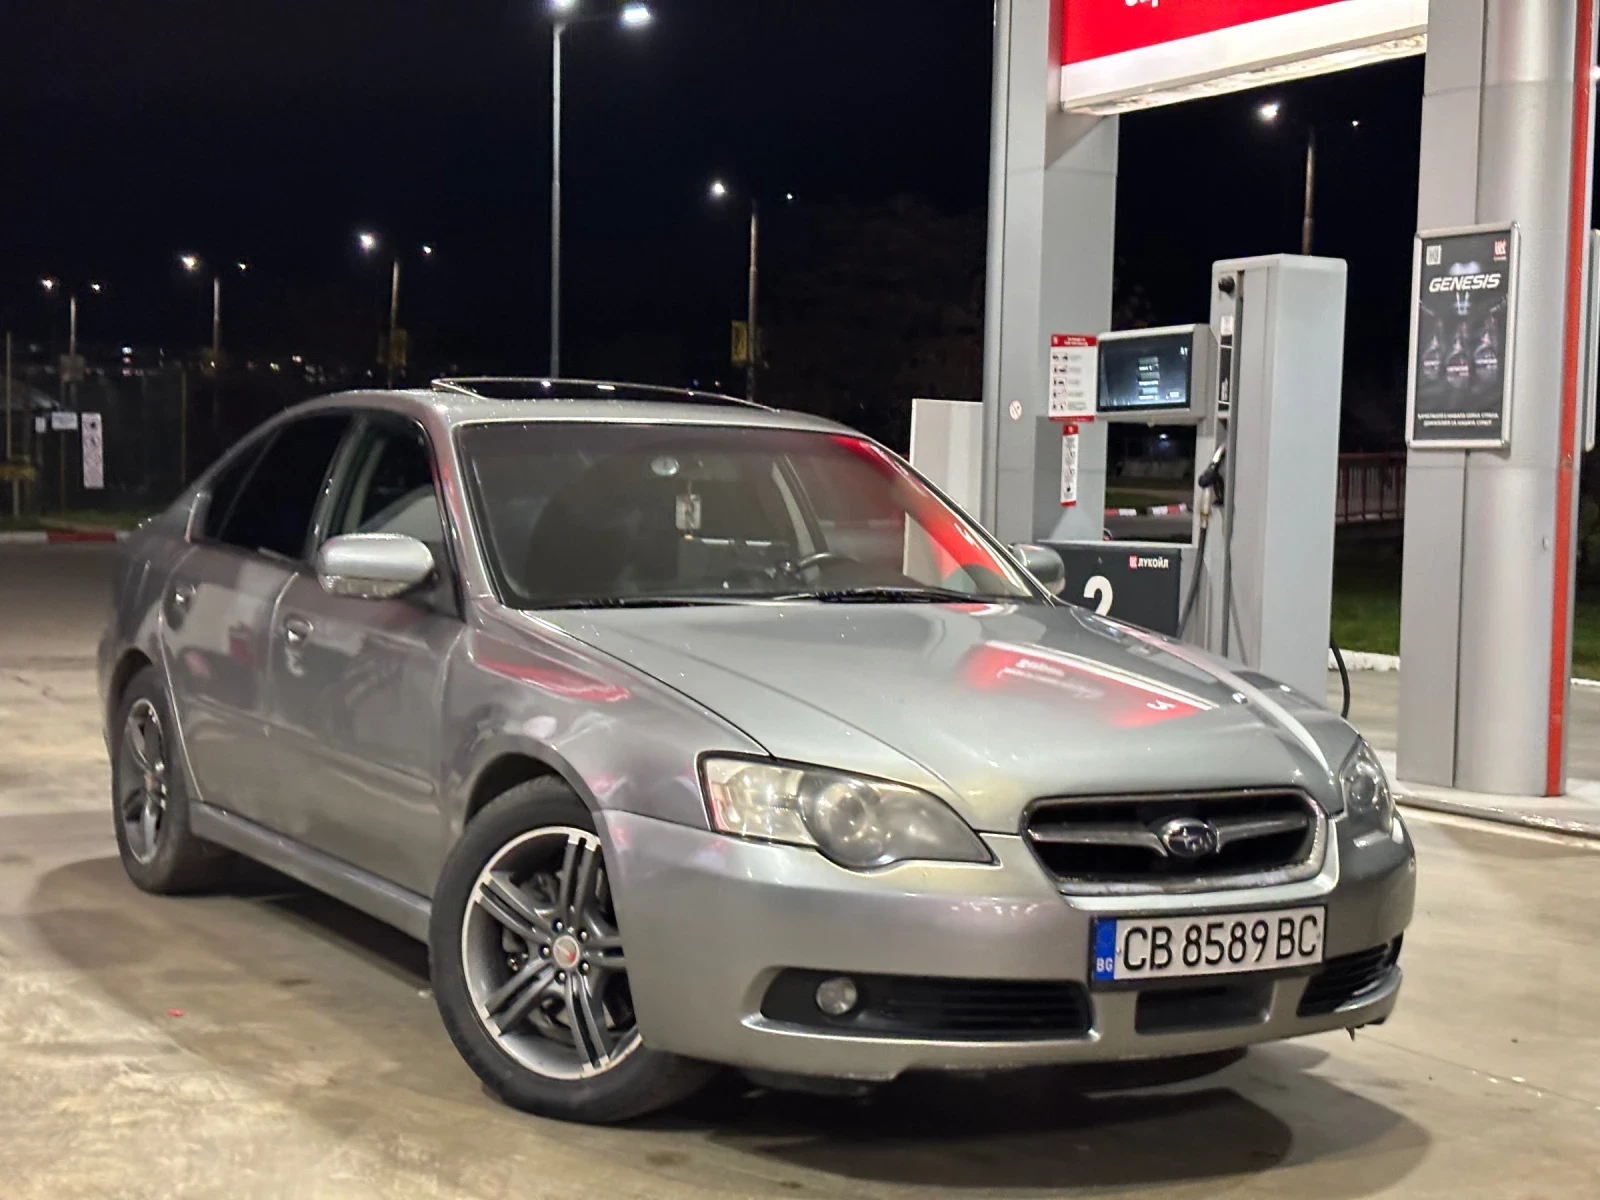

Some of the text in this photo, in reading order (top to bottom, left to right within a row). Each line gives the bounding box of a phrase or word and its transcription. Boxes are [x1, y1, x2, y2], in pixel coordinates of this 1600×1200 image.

[1429, 273, 1502, 293] GENESIS
[1138, 556, 1169, 570] ЛУКОЙЛ
[1083, 575, 1114, 616] 2
[1123, 914, 1318, 971] CB 8589 BC
[1096, 957, 1113, 972] BG
